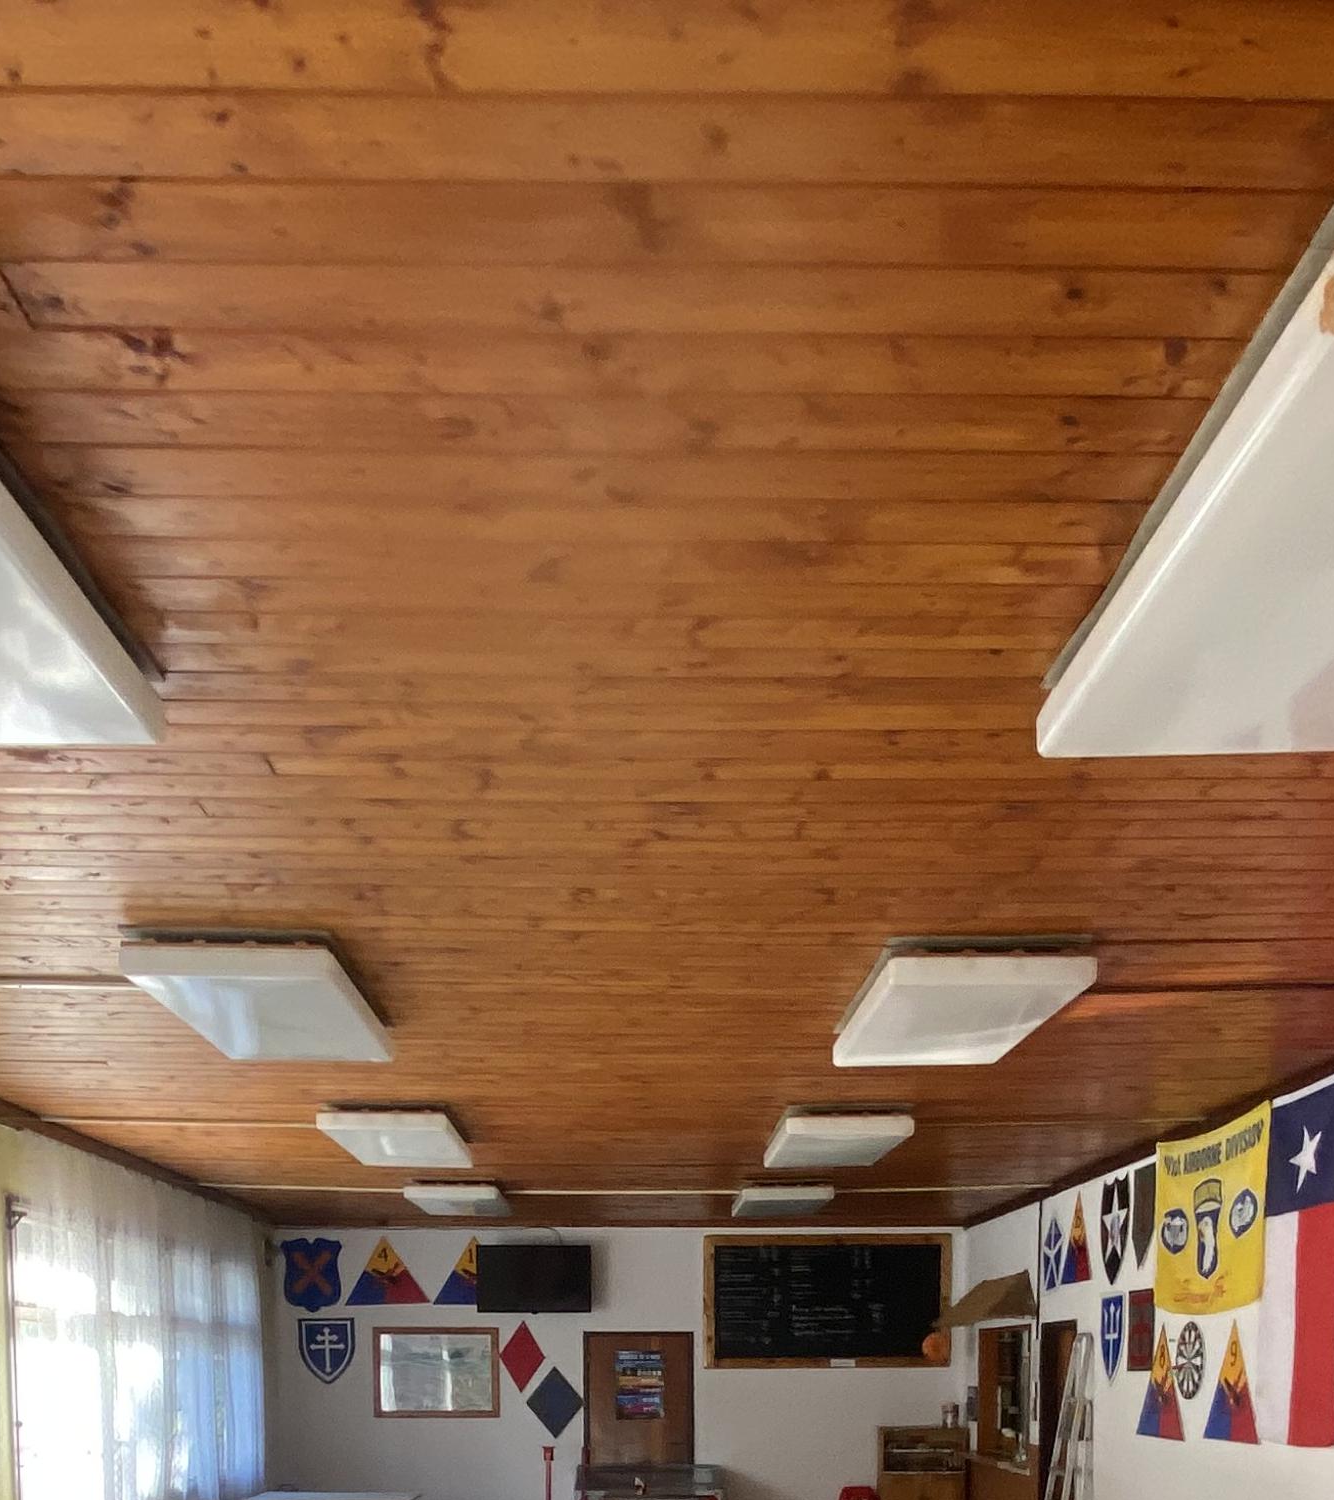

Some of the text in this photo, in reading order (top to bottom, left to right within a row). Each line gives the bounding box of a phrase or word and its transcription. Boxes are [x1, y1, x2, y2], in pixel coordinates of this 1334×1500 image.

[377, 1247, 388, 1262] 4
[1159, 1344, 1166, 1369] 8
[1230, 1340, 1238, 1367] 9
